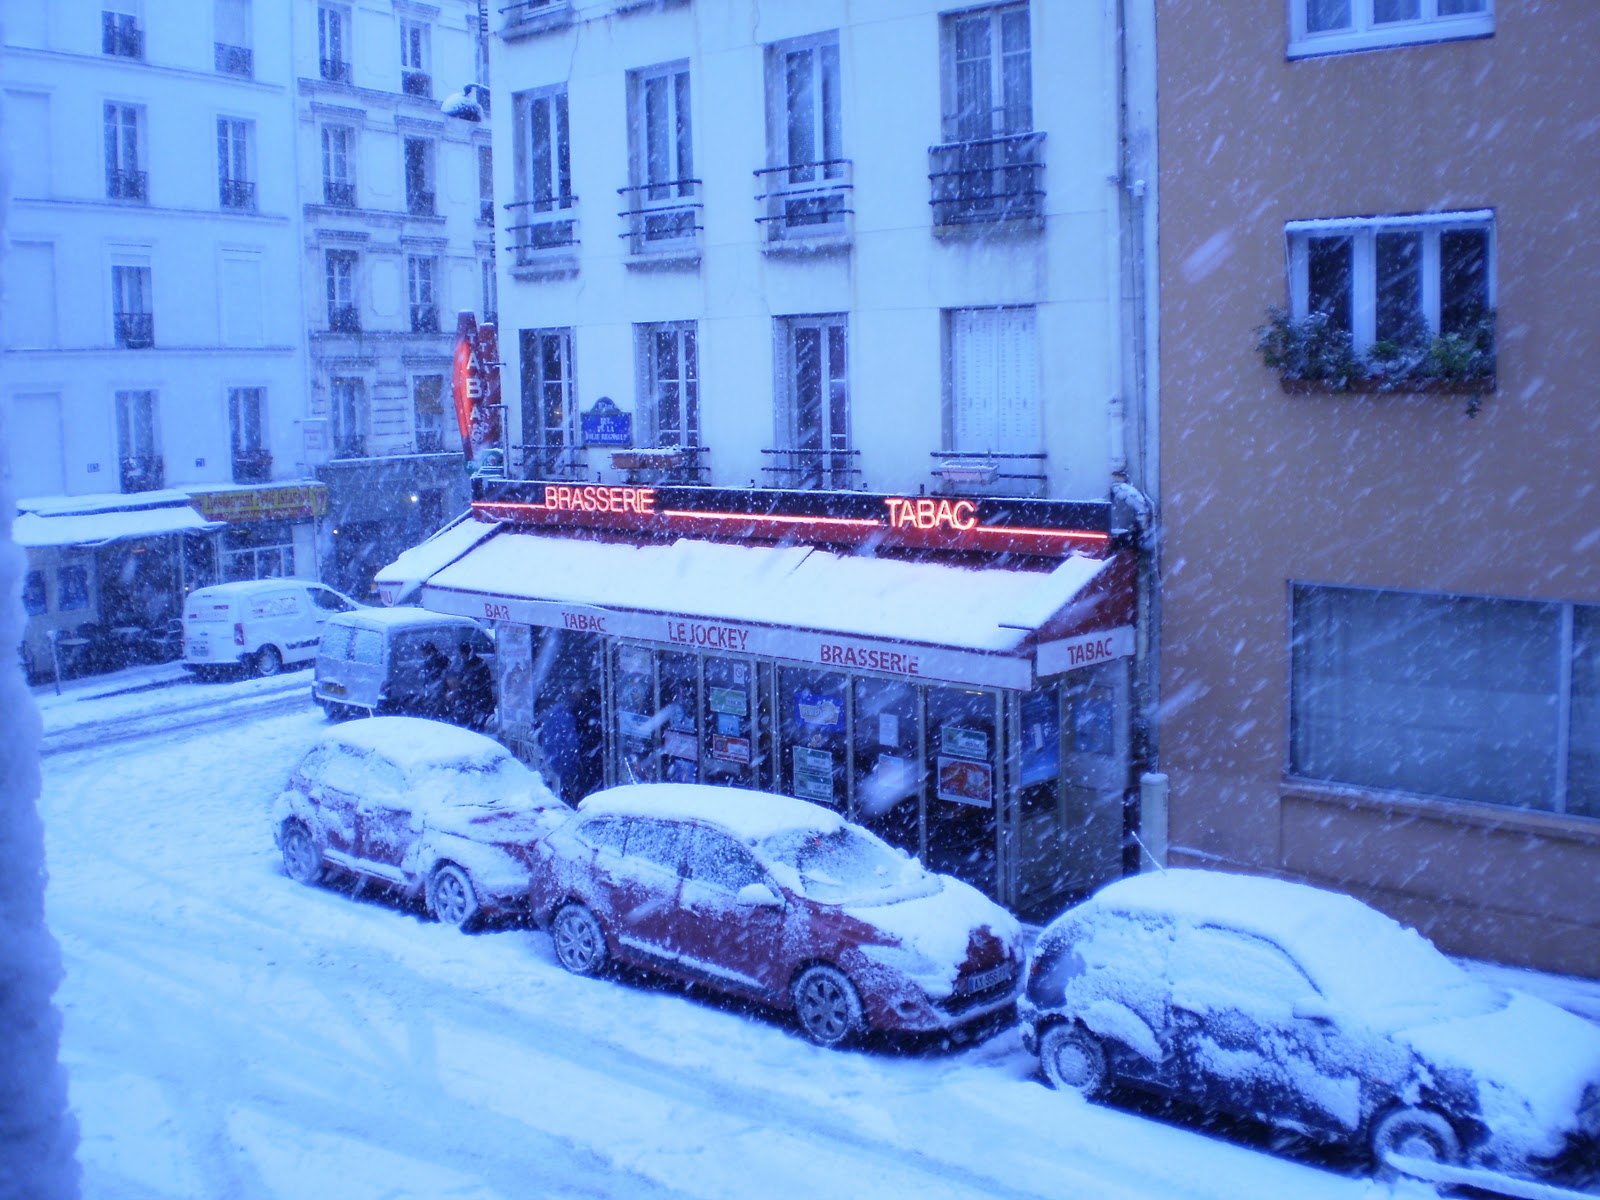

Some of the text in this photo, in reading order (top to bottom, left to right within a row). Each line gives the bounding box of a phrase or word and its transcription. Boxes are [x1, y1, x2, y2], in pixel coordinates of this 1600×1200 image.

[465, 332, 484, 444] TABAC
[544, 486, 655, 514] BRASSERIE
[884, 498, 976, 531] TABAC
[484, 603, 511, 620] BAR
[561, 612, 606, 632] TABAC
[668, 621, 749, 650] LE JOCKEY
[820, 644, 919, 674] BRASSERIE
[1067, 637, 1113, 665] TABAC
